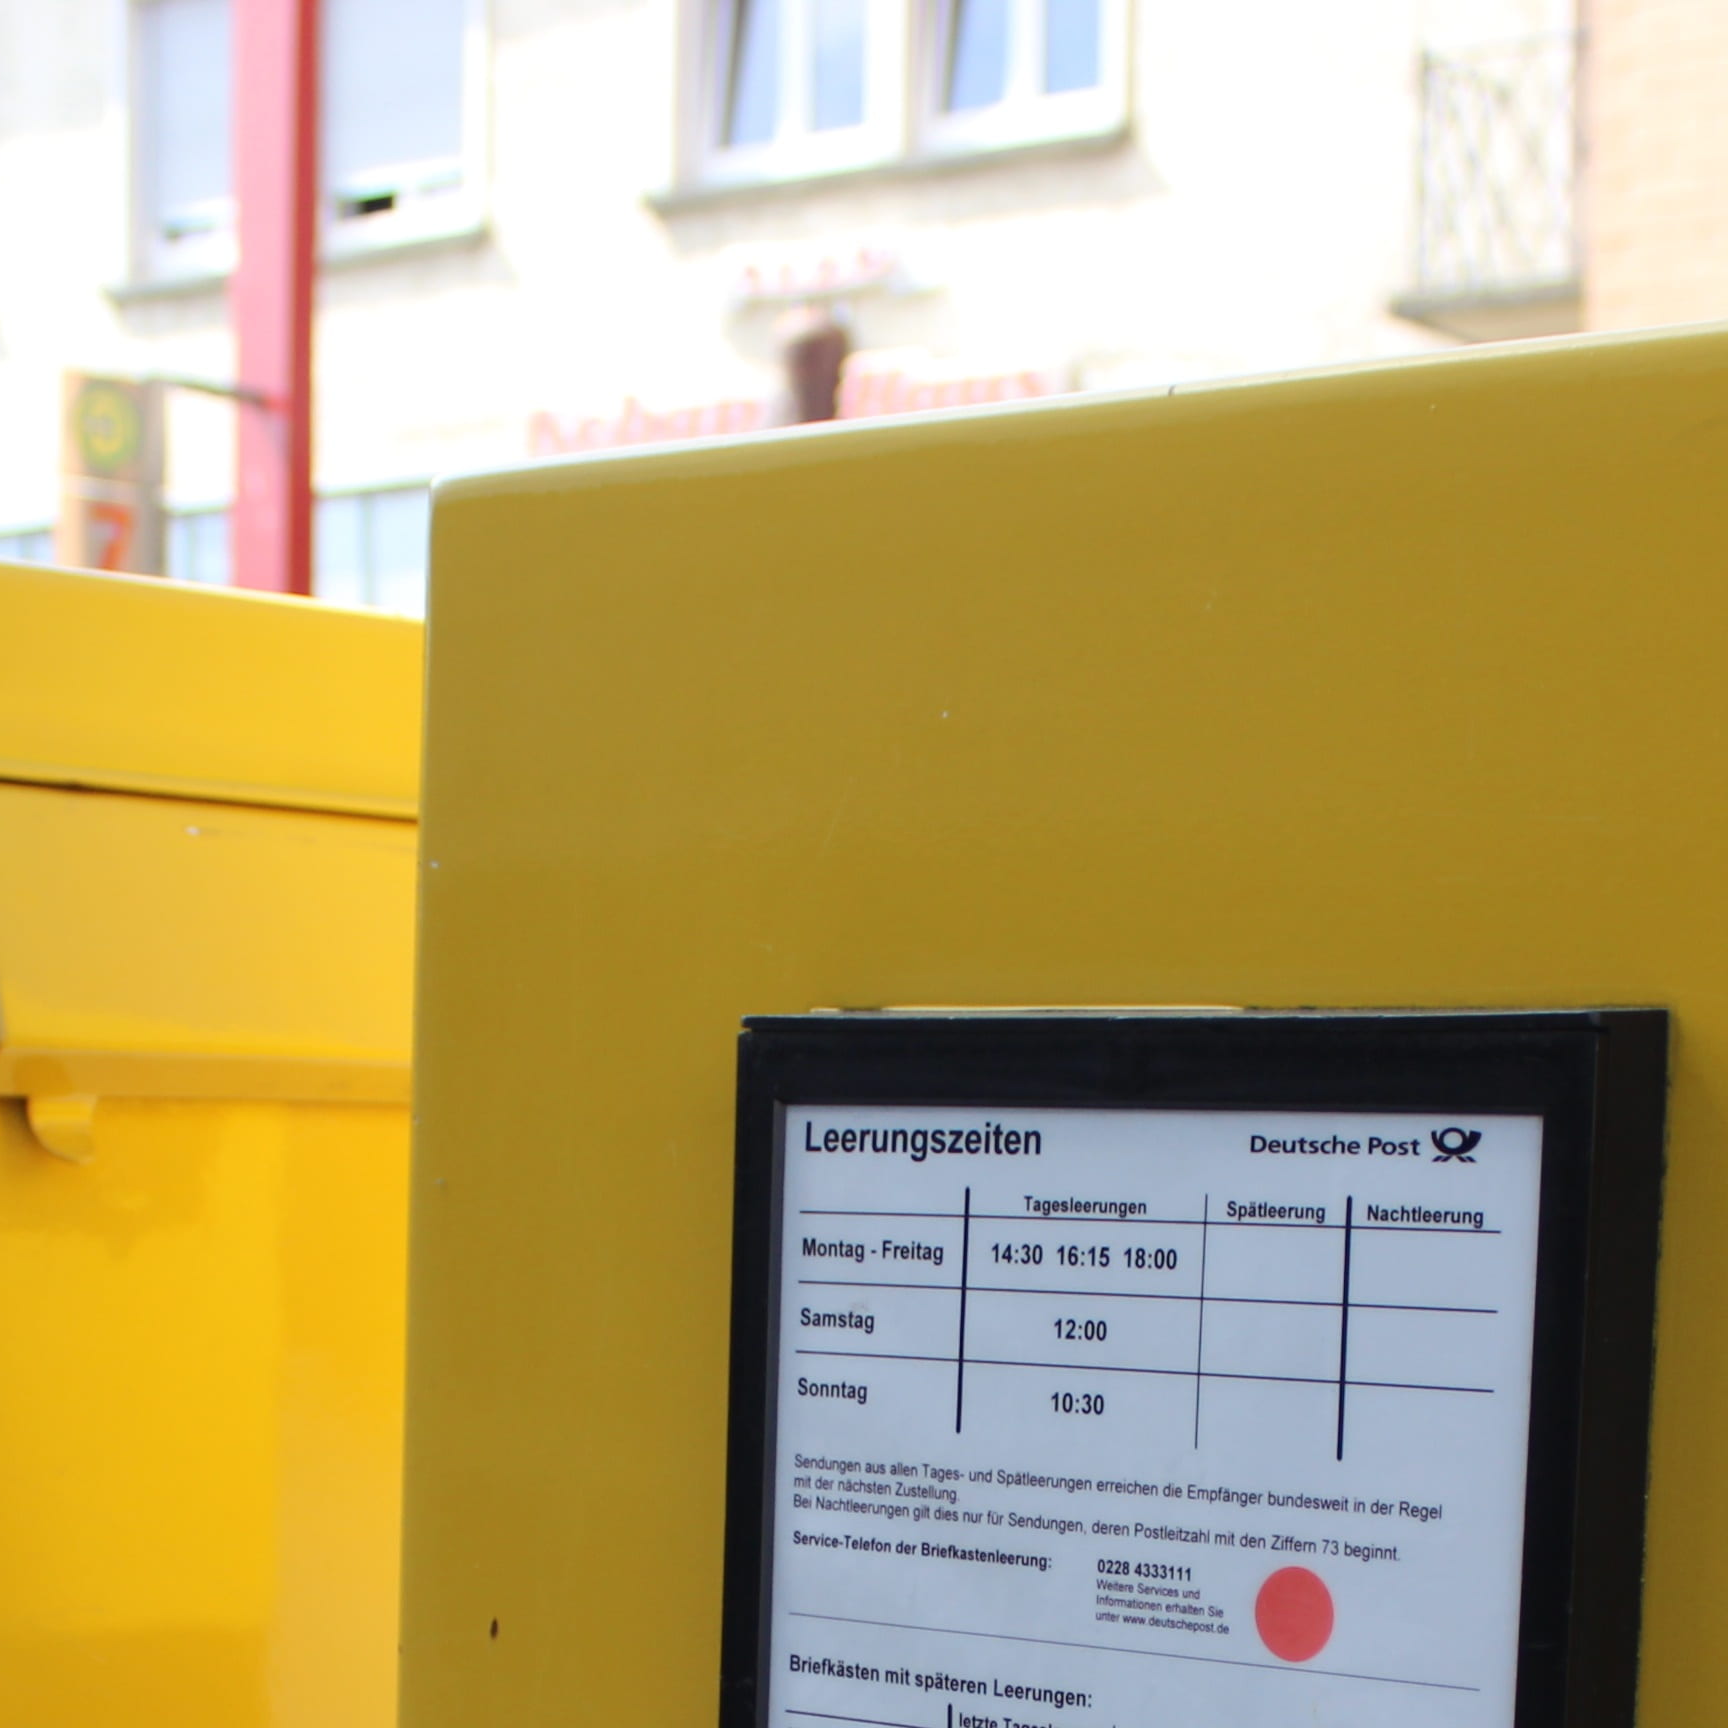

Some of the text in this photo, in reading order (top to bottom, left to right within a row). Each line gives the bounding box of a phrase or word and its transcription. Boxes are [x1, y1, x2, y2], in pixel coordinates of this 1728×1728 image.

[805, 1121, 1042, 1162] Leerungszeiten
[1250, 1134, 1421, 1156] Deutsche Post
[1024, 1195, 1147, 1218] Tagesleerungen
[1226, 1200, 1326, 1224] Spätleerung
[1367, 1204, 1484, 1229] Nachtleerung
[802, 1238, 866, 1262] Montag
[882, 1240, 944, 1265] Freitag
[991, 1243, 1177, 1270] 14:30 16:15 18:00
[799, 1307, 876, 1336] Samstag
[1053, 1318, 1108, 1343] 12:00
[797, 1377, 869, 1406] Sonntag
[1050, 1391, 1105, 1416] 10:30
[794, 1453, 1443, 1522] Sendungen aus allen Tages- und Spätleerungen erreichen die Empfänger bundesweit in der Regel
[794, 1475, 960, 1504] mit der nächsten Zustellung.
[793, 1494, 1401, 1562] Bei Nachtleerungen gilt dies nur für Sendungen, deren Postleitzahl mit den Ziffern 73 beginnt.
[792, 1530, 1053, 1572] Service-Telefon der Briefkastenleerung:
[1097, 1558, 1193, 1583] 0228 4333111
[1096, 1578, 1201, 1601] Weitere Services und
[1096, 1594, 1225, 1619] Informationen erhalten Sie
[1095, 1610, 1230, 1636] unter www.deutschepost.de
[789, 1653, 1094, 1709] Briefkästen mit späteren Leerungen:
